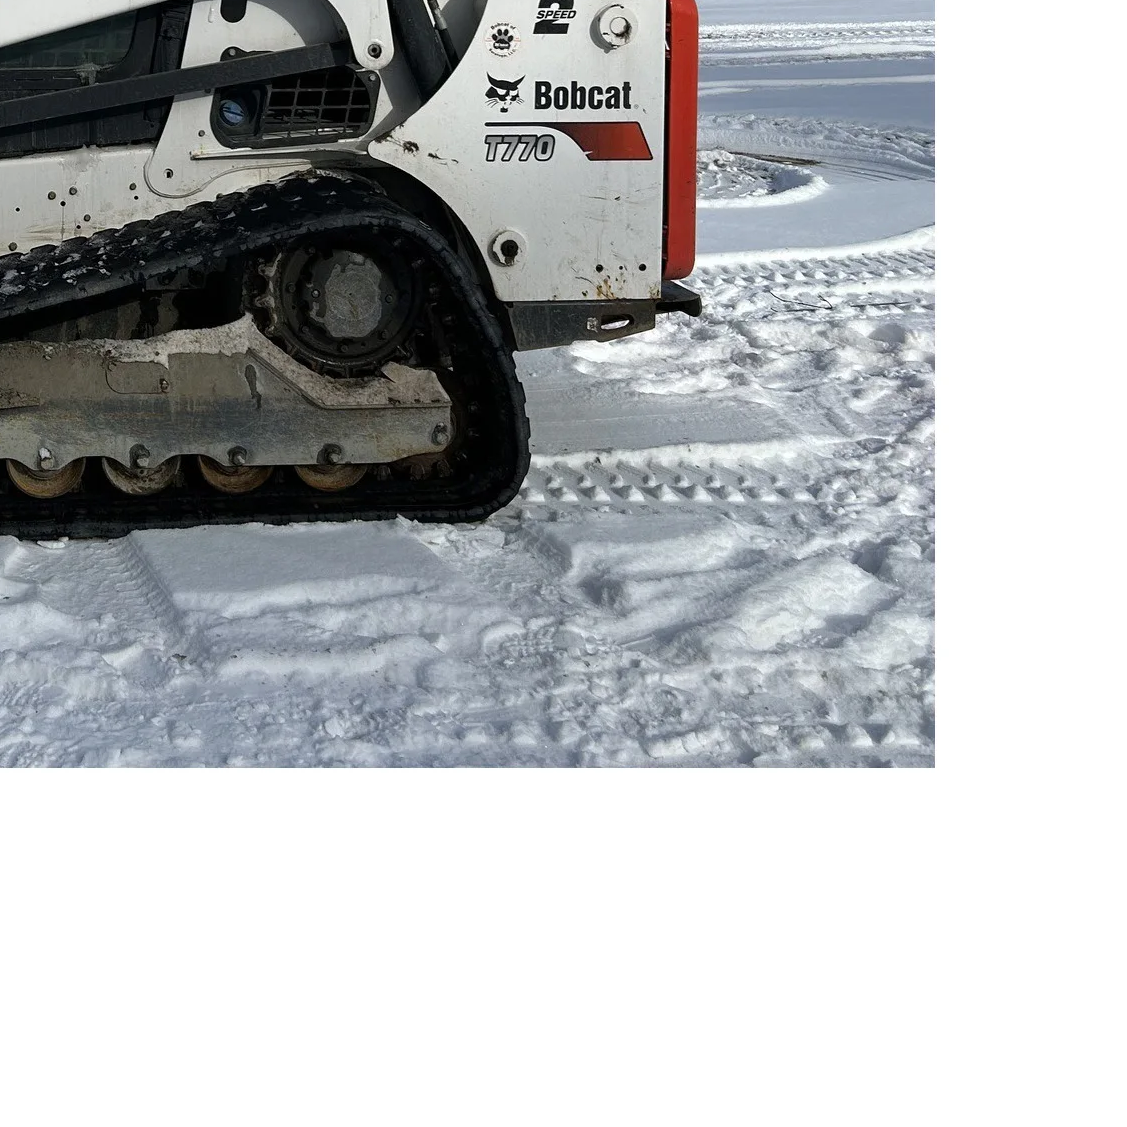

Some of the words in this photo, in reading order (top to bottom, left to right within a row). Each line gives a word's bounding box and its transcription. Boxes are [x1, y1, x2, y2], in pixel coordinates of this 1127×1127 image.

[536, 10, 577, 19] SPEED
[534, 80, 632, 110] Bobcat
[484, 134, 556, 162] T770
